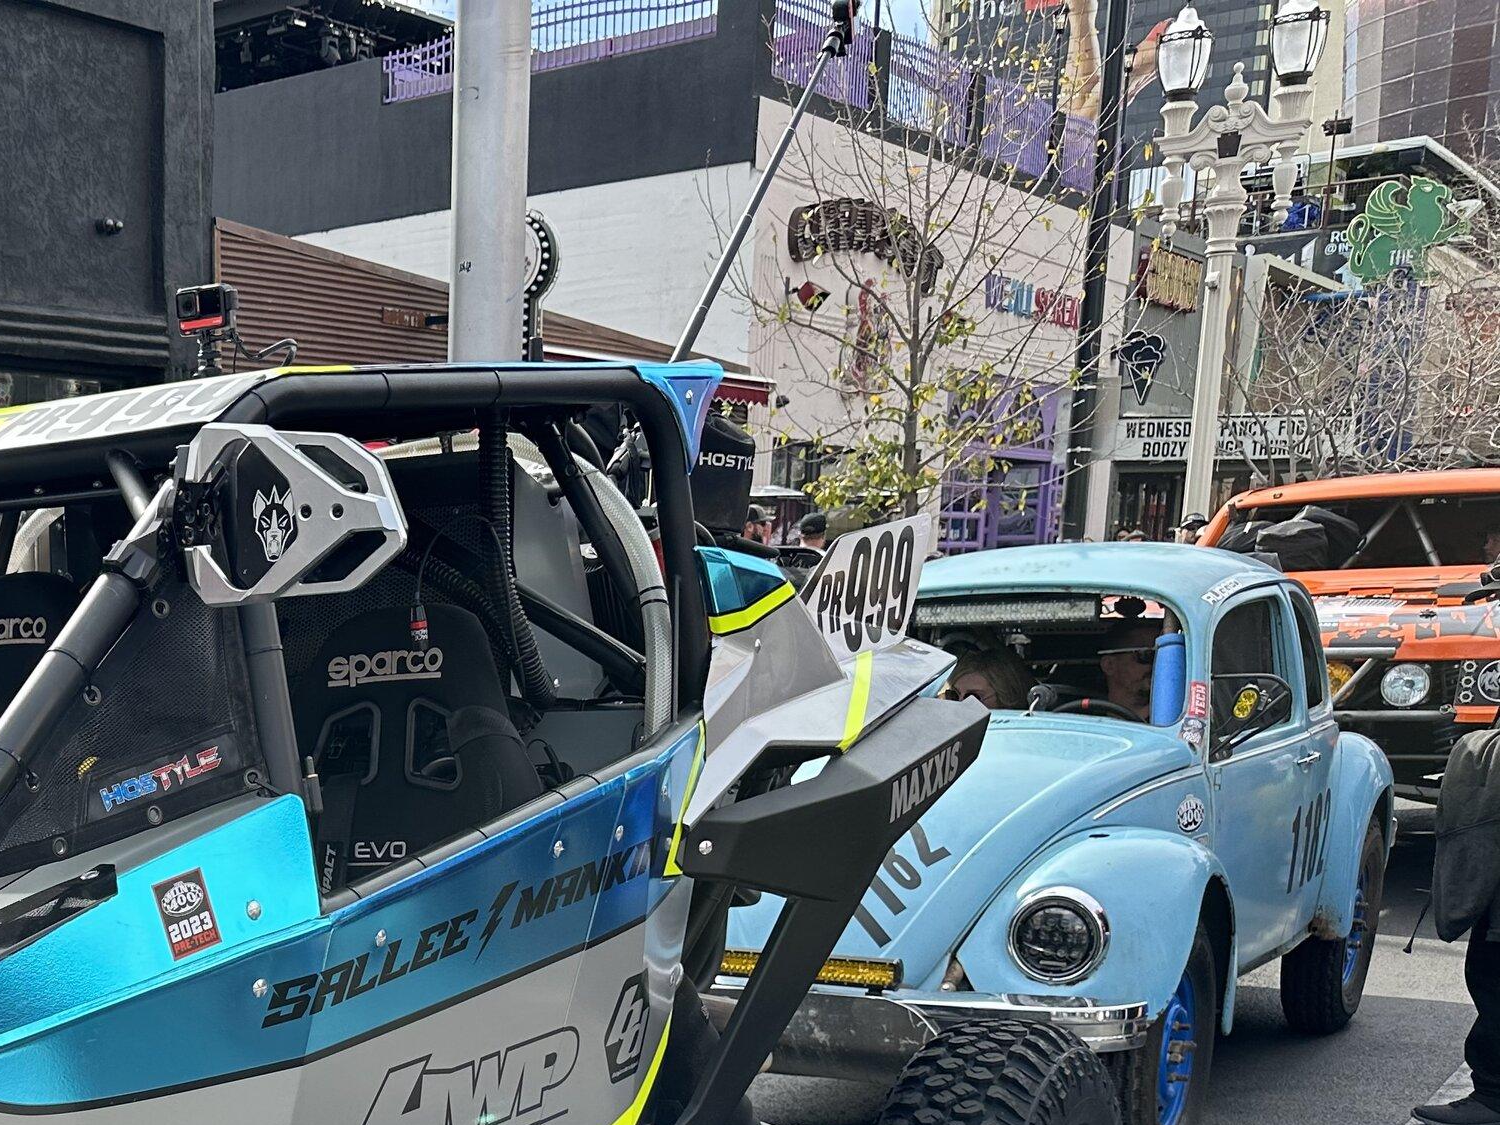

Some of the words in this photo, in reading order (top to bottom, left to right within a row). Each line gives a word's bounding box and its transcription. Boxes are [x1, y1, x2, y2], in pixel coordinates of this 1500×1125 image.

[1126, 421, 1190, 438] WEDNESD
[699, 452, 755, 471] HOSTYL
[1142, 441, 1187, 458] BOOZY
[328, 646, 443, 687] sparco
[100, 745, 222, 812] HOSTYLE
[889, 741, 962, 823] MAXXIS
[354, 841, 407, 859] EVO
[169, 891, 198, 911] 400
[168, 911, 213, 943] 2023
[261, 909, 479, 1029] SALLEE
